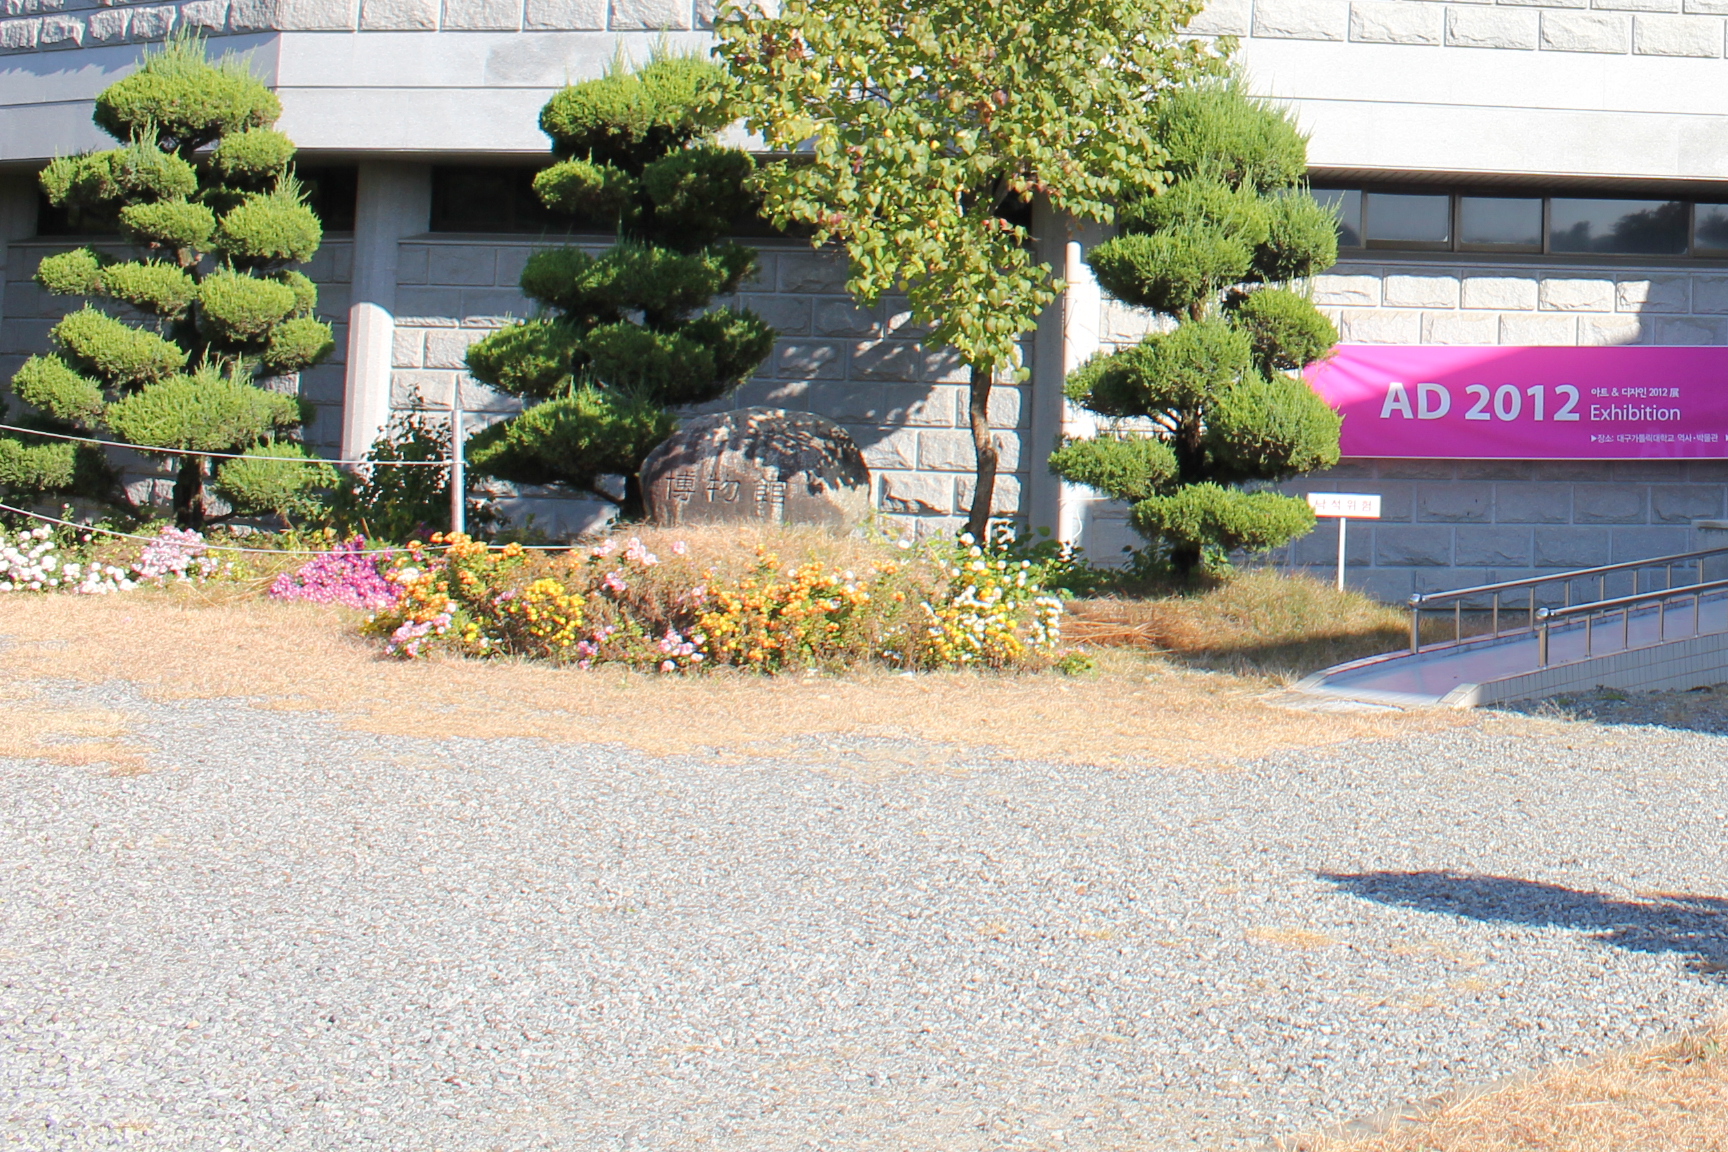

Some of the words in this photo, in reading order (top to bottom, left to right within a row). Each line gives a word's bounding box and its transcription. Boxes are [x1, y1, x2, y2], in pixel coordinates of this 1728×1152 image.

[1379, 381, 1451, 420] AD
[1464, 383, 1581, 422] 2012
[1590, 387, 1610, 398] 아트
[1611, 387, 1620, 397] &
[1621, 387, 1648, 398] 디자인
[1648, 387, 1669, 397] 2012
[1590, 403, 1682, 421] Exhibition
[665, 469, 787, 505] 博物館
